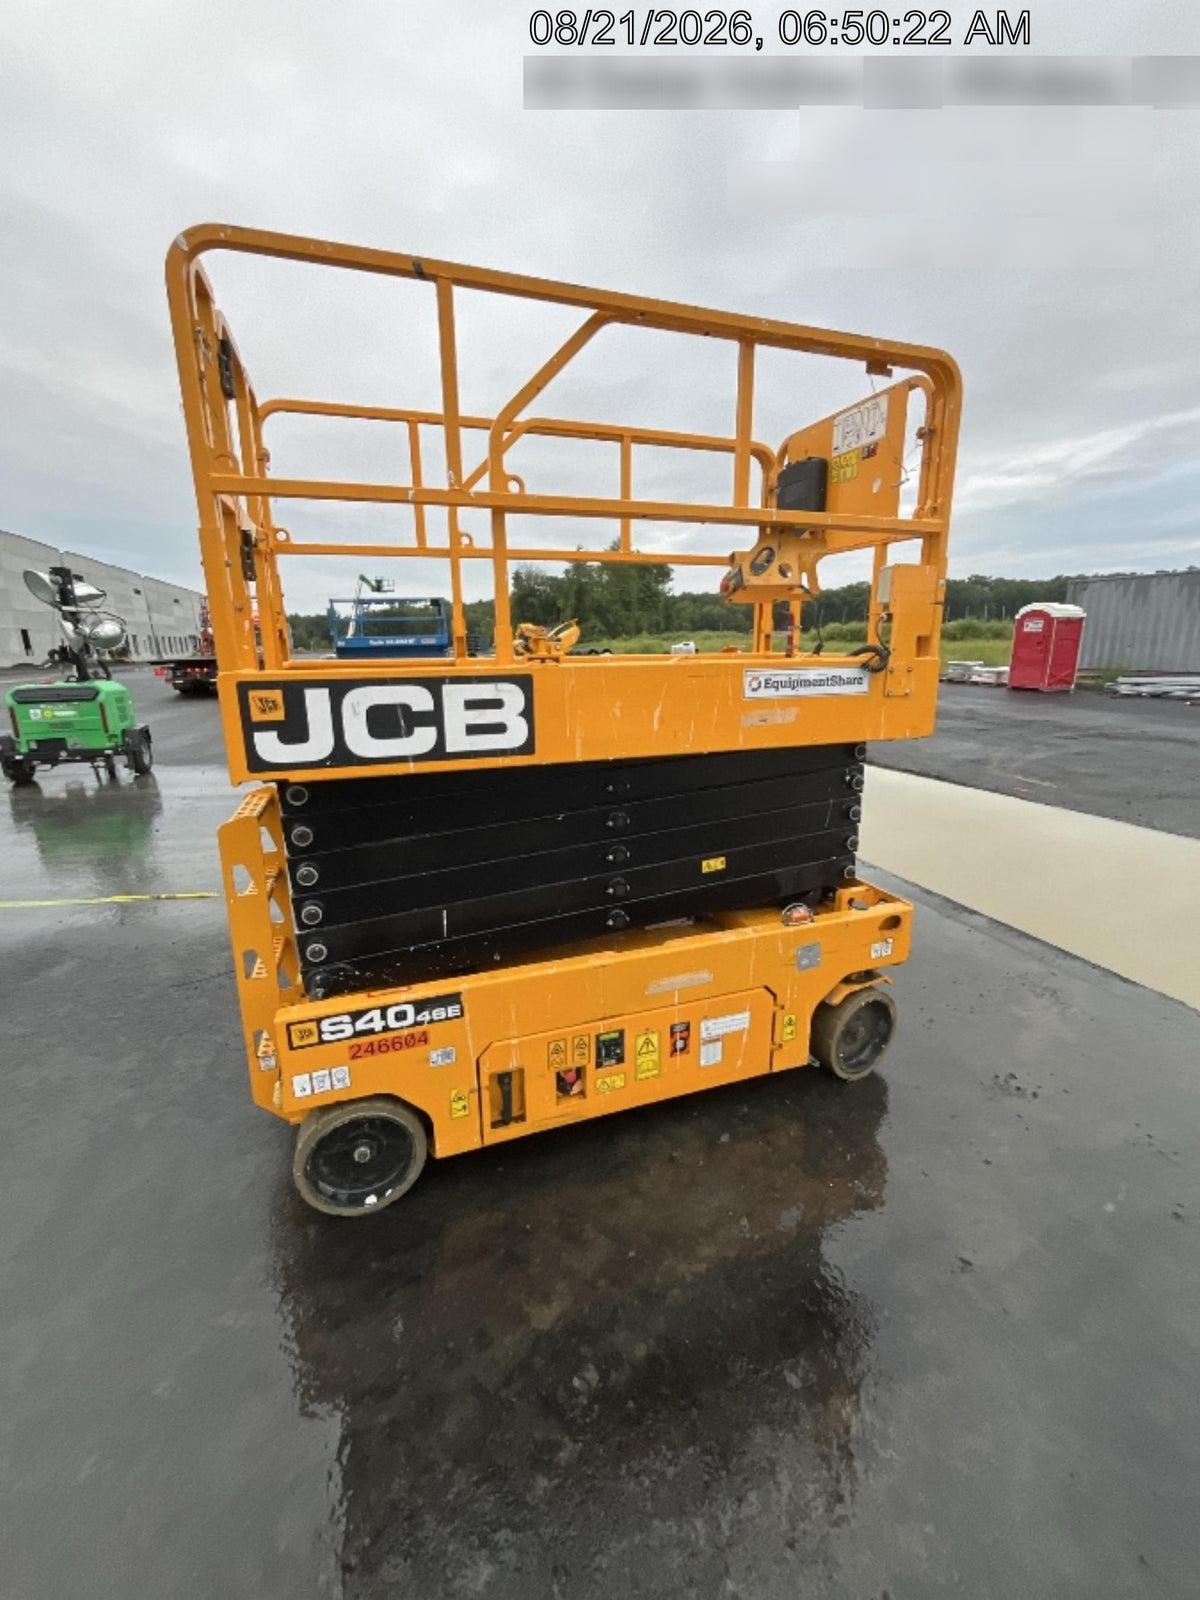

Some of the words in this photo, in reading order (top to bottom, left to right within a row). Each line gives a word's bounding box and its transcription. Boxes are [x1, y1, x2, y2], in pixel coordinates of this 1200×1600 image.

[764, 674, 863, 690] EquipmentShare
[254, 683, 528, 763] JCB
[350, 1031, 428, 1060] 246604
